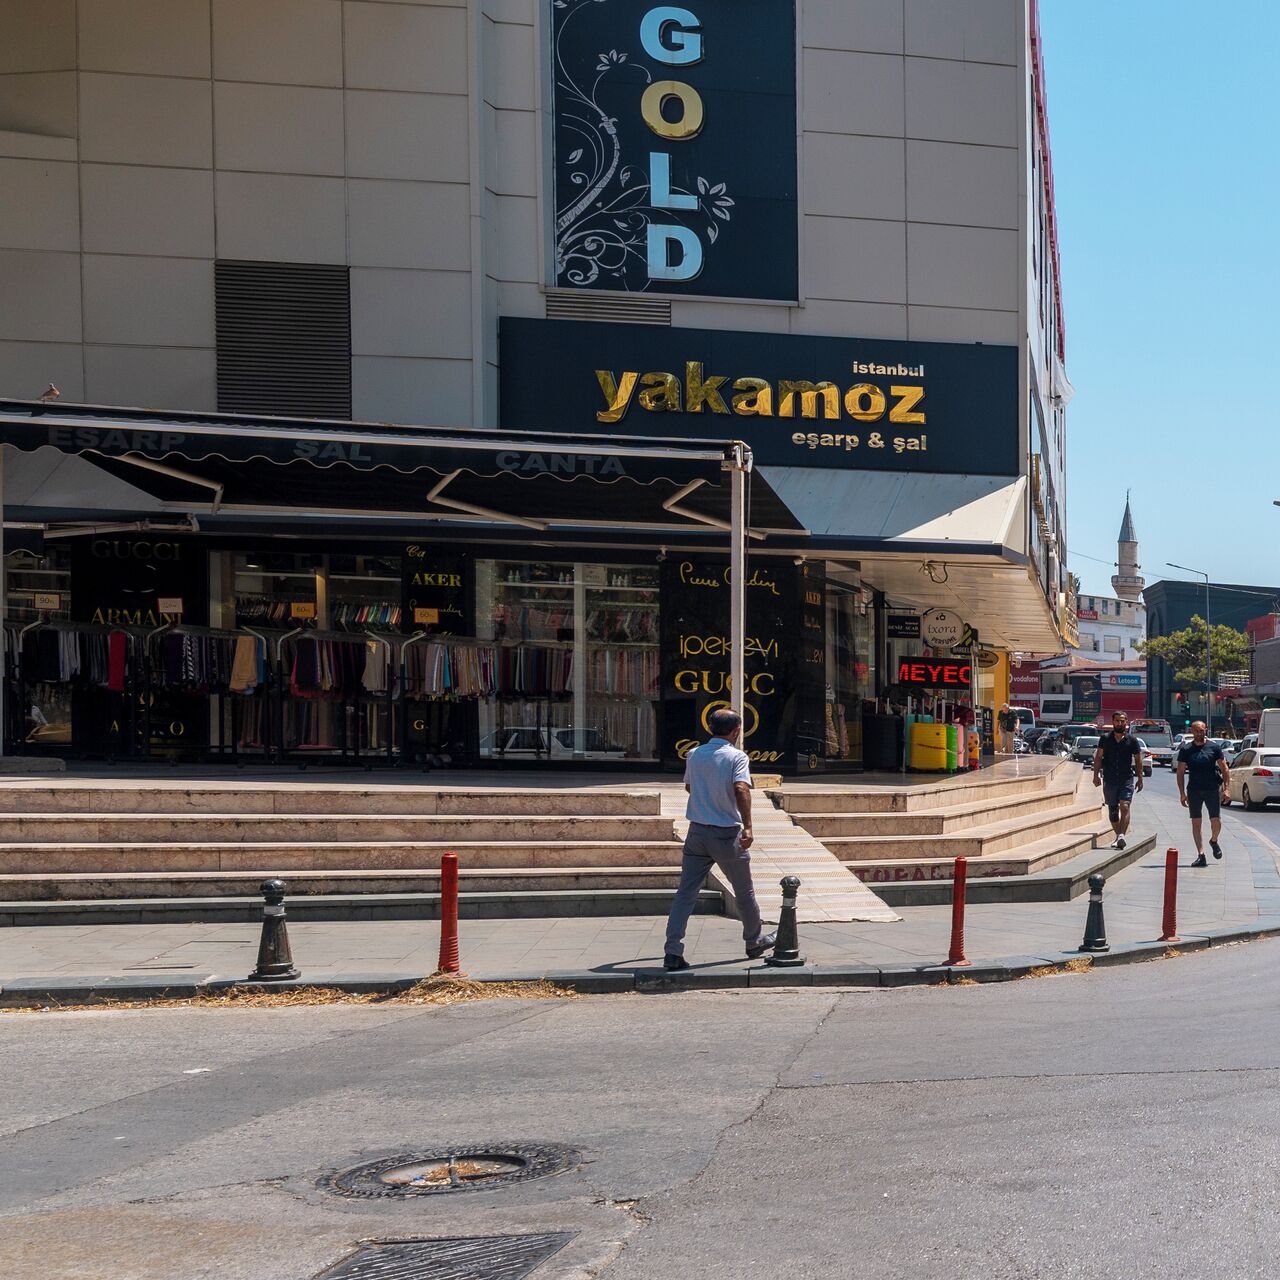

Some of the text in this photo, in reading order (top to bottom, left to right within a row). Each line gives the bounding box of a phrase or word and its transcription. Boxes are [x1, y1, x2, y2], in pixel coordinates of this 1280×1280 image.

[640, 6, 705, 282] GOLD
[852, 361, 925, 377] istanbul
[596, 361, 927, 425] yakamoz
[791, 432, 927, 454] eşarp & şal
[411, 573, 462, 587] AKER
